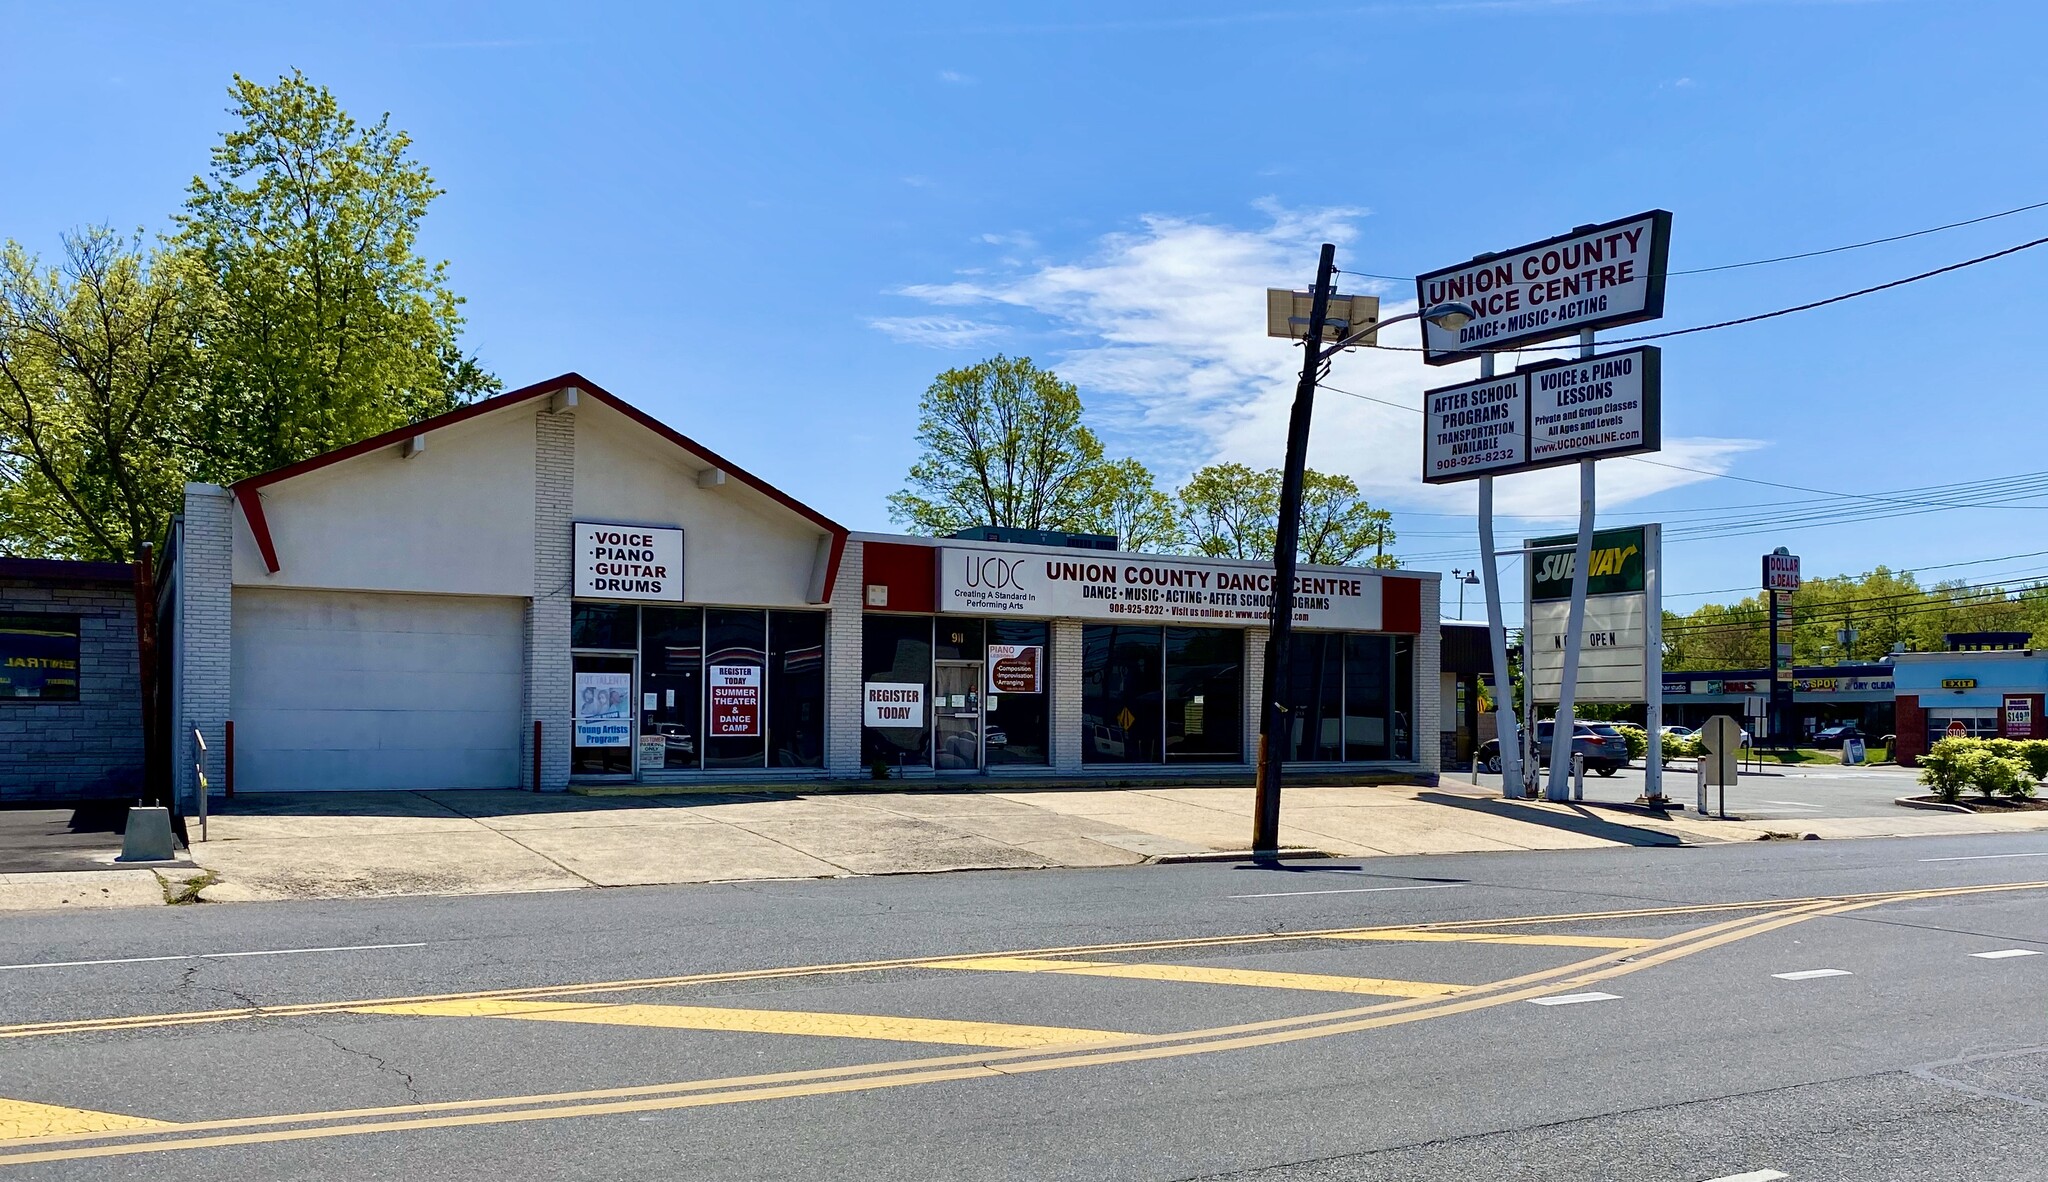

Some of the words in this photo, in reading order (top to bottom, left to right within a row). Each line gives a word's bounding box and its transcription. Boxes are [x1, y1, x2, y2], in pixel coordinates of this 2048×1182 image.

[1429, 263, 1513, 304] UNION
[1522, 226, 1644, 281] COUNTY
[1528, 260, 1634, 305] CENTRE
[1460, 320, 1498, 343] DANCE
[1507, 308, 1549, 332] MUSIC
[1558, 294, 1607, 320] ACTING
[1540, 369, 1578, 391] VOICE
[1580, 369, 1589, 383] &
[1592, 358, 1632, 381] PIANO
[1434, 393, 1468, 413] AFTER
[1471, 383, 1518, 406] SCHOOL
[1557, 381, 1613, 407] LESSONS
[1442, 403, 1509, 429] PROGRAMS
[1535, 413, 1561, 426] Private
[1562, 409, 1577, 420] and
[1579, 405, 1603, 418] Group
[1604, 400, 1638, 413] Classes
[1437, 421, 1515, 445] TRANSPORTATION
[1548, 426, 1558, 436] All
[1560, 424, 1579, 435] Ages
[1580, 419, 1595, 430] and
[1597, 415, 1623, 428] Levels
[1452, 437, 1498, 455] AVAILABLE
[1534, 430, 1640, 453] www.UCDCONLINE.com
[1437, 449, 1514, 469] 908-925-8232
[595, 532, 653, 547] VOICE
[595, 547, 654, 562] PIANO
[595, 563, 667, 578] GUITAR
[1770, 557, 1799, 572] DOLLAR
[966, 556, 1025, 591] UCDC
[1046, 562, 1116, 583] UNION
[1124, 566, 1211, 589] COUNTY
[1771, 575, 1776, 584] &
[1777, 574, 1799, 588] DEALS
[595, 578, 662, 593] DRUMS
[954, 589, 986, 599] Creating
[995, 591, 1027, 601] Standard
[1083, 585, 1117, 600] DANCE
[1125, 587, 1159, 602] MUSIC
[1166, 590, 1202, 604] ACTING
[1209, 592, 1237, 606] AFTER
[1240, 594, 1275, 608] SCHOO
[1291, 597, 1330, 610] OGRAMS
[966, 599, 1007, 610] Performing
[1109, 603, 1164, 615] 908-925-8232
[1171, 606, 1188, 616] Visit
[1190, 608, 1198, 616] us
[1200, 608, 1223, 618] online
[1225, 610, 1234, 618] at:
[990, 646, 1015, 654] PIANO
[719, 668, 752, 676] REGISTER
[724, 677, 747, 685] TODAY
[1810, 679, 1837, 688] SPOT
[1853, 682, 1868, 690] DRY
[869, 689, 919, 702] REGISTER
[720, 715, 751, 723] DANCE
[877, 707, 911, 719] TODAY
[577, 725, 602, 735] Young
[602, 725, 629, 734] Artists
[722, 724, 749, 732] CAMP
[1948, 729, 1965, 737] STOP
[586, 735, 619, 744] Program
